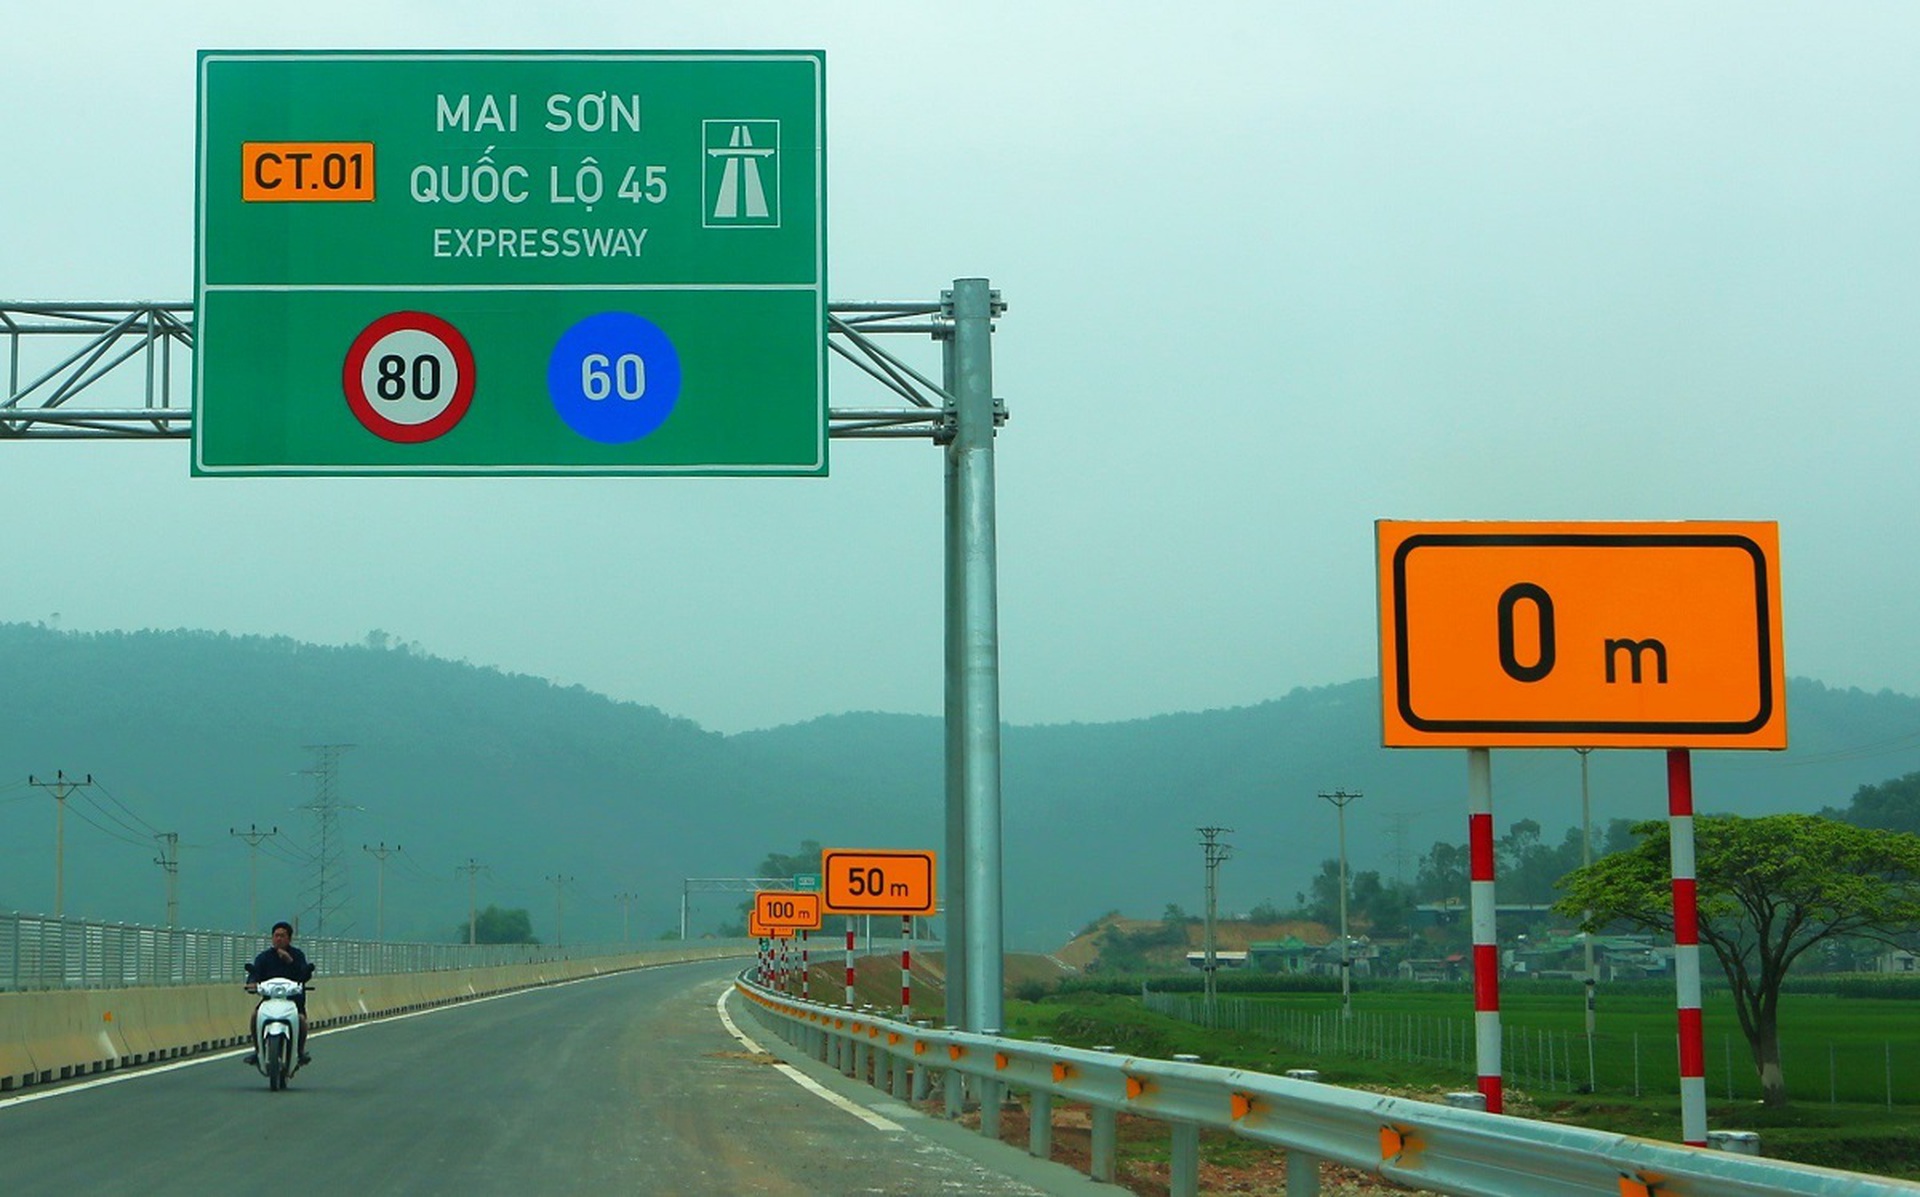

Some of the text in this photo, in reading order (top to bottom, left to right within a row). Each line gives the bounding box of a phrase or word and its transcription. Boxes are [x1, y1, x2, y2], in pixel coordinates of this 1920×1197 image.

[436, 90, 640, 132] MAI SƠN
[254, 152, 363, 190] CT.01
[410, 145, 668, 212] QUỐC LỘ 45
[434, 228, 648, 257] EXPRESSWAY
[376, 354, 441, 401] 80
[582, 353, 646, 401] 60
[1497, 582, 1668, 684] 0 m
[848, 867, 909, 897] 50 m
[767, 901, 811, 919] 100 m
